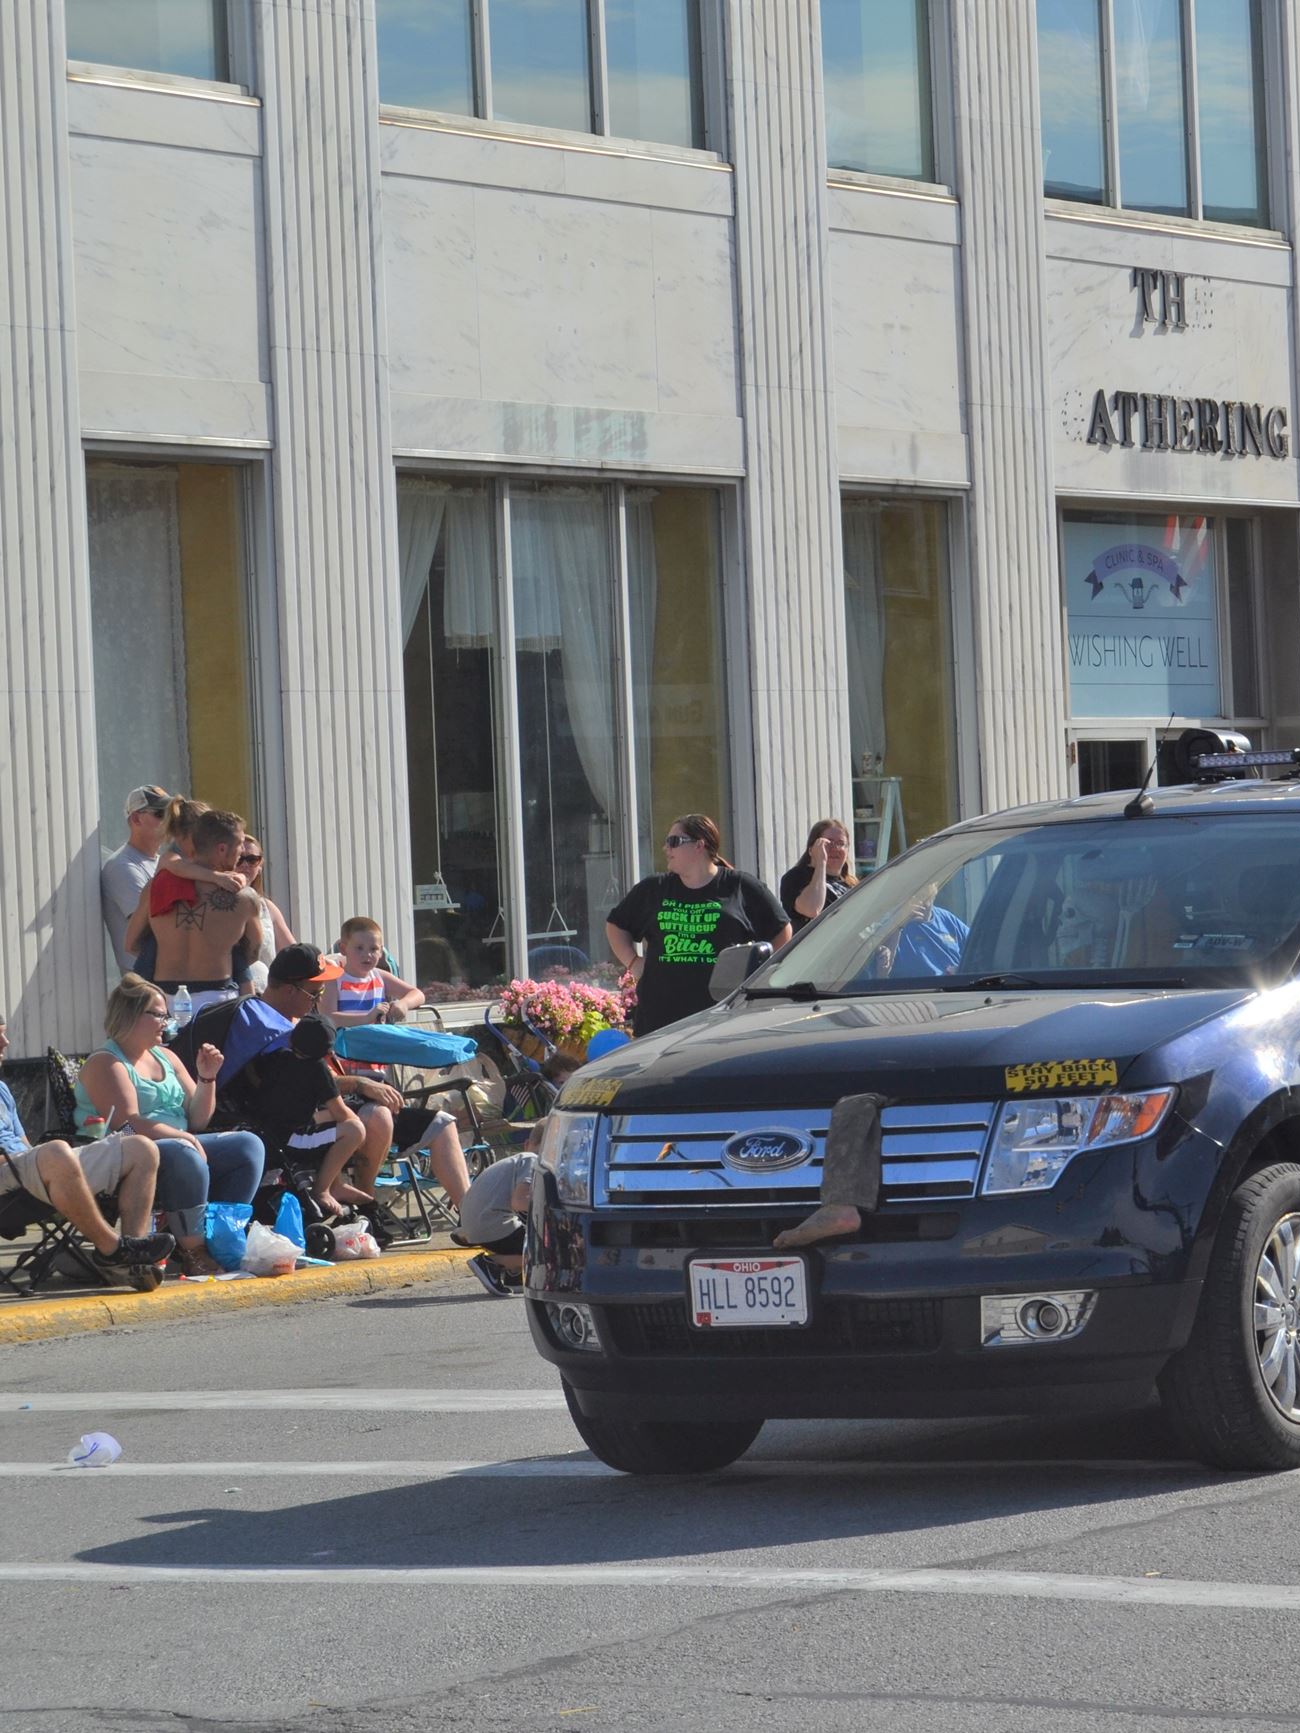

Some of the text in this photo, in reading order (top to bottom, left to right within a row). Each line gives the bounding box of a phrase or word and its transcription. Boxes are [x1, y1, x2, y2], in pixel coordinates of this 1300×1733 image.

[1087, 388, 1290, 459] ATHERING
[1104, 549, 1164, 572] CLINIC & SPA
[1069, 633, 1209, 668] WISHING WELL
[657, 911, 720, 923] SUCK IT UP
[659, 922, 717, 932] BUTTERCUP
[663, 934, 715, 954] Bitch
[1007, 1062, 1113, 1078] STAY BACK
[1024, 1072, 1099, 1086] 50 FEET
[739, 1136, 785, 1158] Ford
[733, 1262, 760, 1273] OHIO
[699, 1275, 796, 1310] HLL 8592
